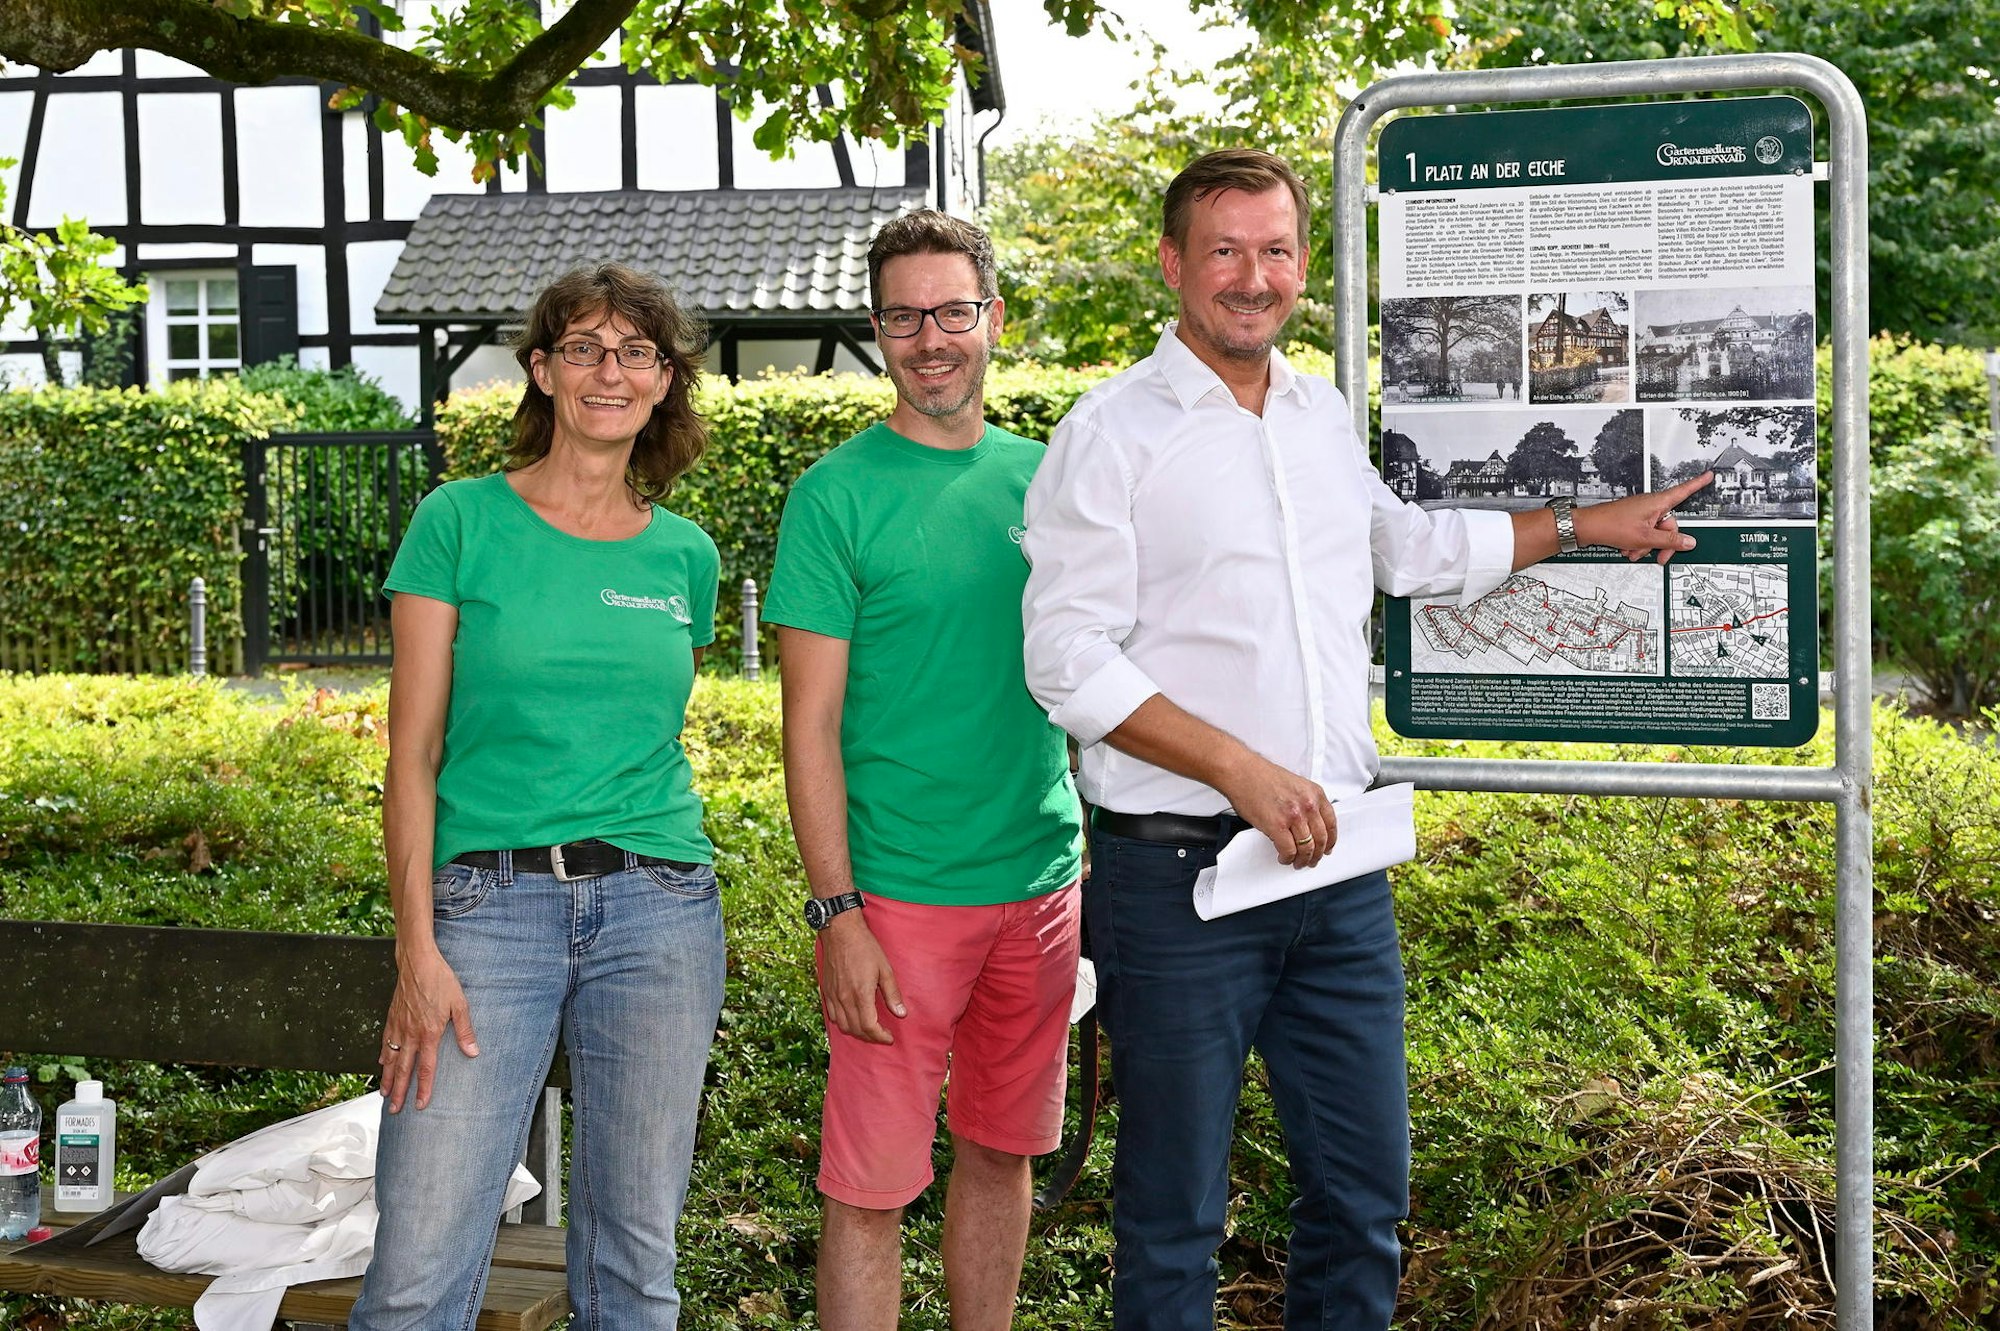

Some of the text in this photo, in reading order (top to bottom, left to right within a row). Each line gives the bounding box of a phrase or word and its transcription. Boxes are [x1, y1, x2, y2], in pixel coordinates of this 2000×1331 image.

[1406, 152, 1565, 182] 1 PLATZ AN DER EICHE
[1740, 533, 1778, 542] STATION 2
[65, 1117, 95, 1127] FORMADES
